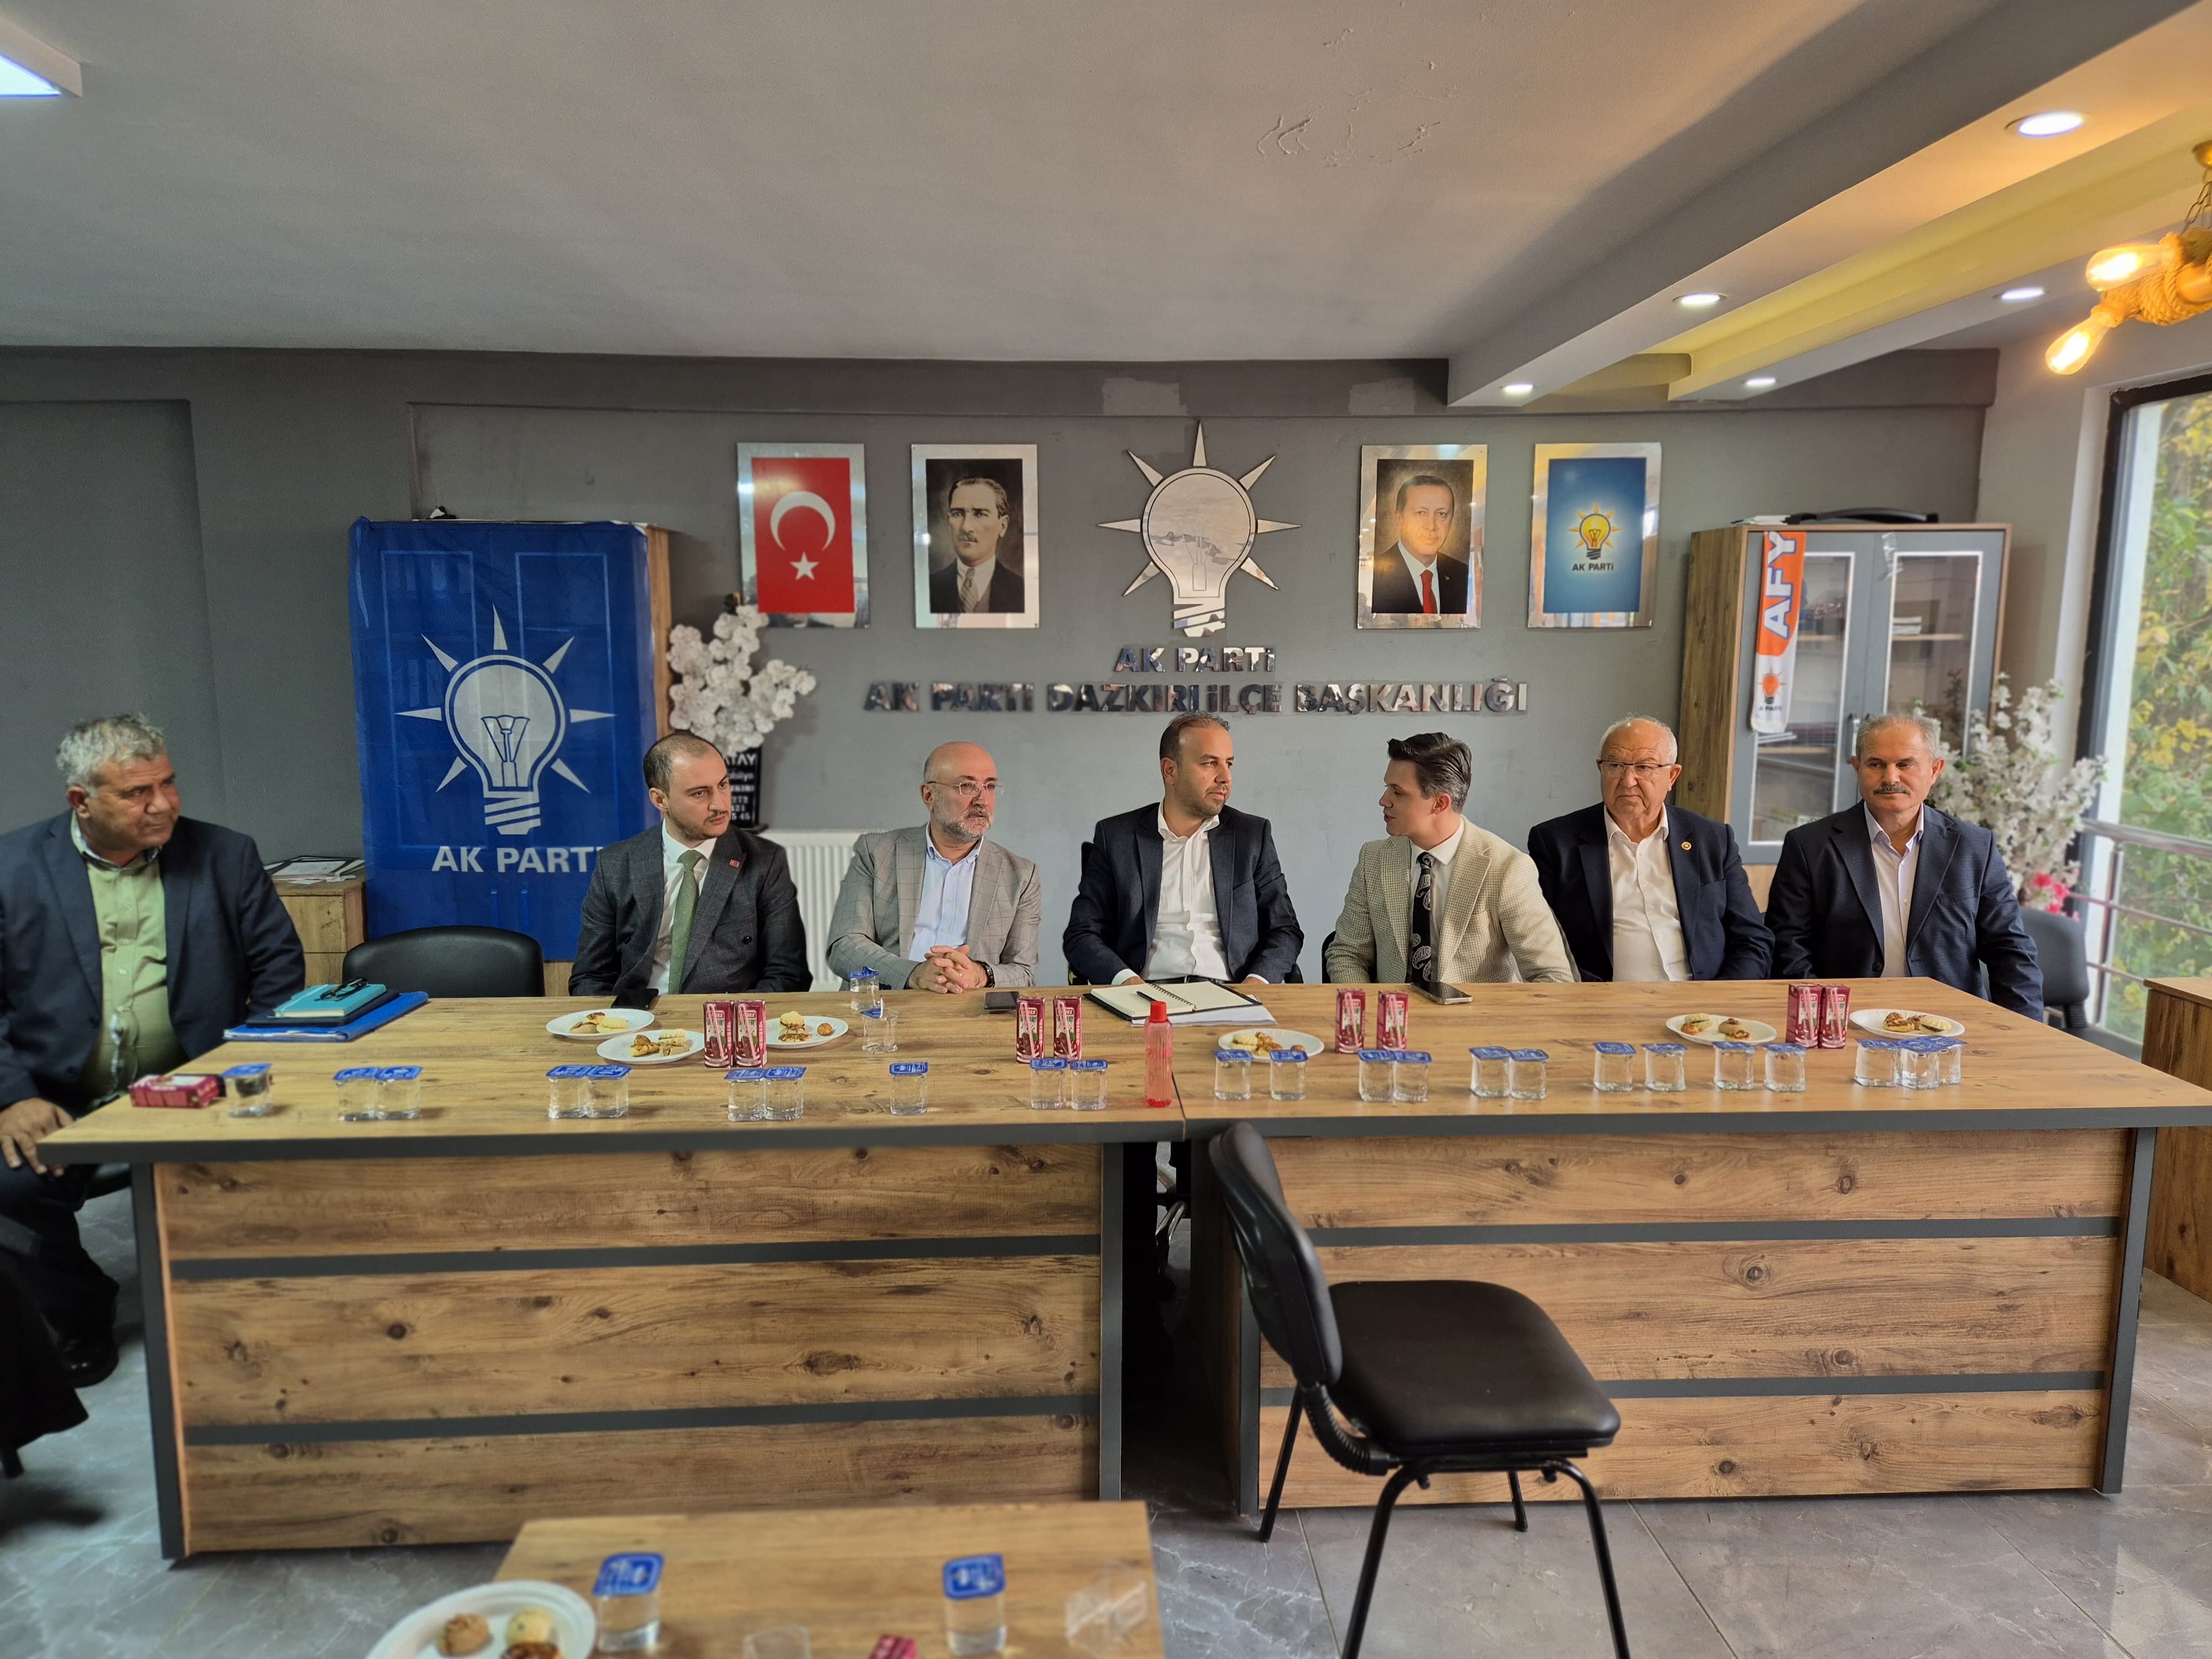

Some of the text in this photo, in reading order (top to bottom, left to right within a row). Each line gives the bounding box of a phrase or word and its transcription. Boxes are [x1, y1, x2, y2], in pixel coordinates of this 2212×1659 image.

[1572, 563, 1585, 571] AK
[1114, 647, 1165, 672] AK
[863, 682, 921, 712] AK
[1047, 684, 1199, 713] DAZKIRI
[1295, 677, 1528, 714] BAŞKANLIĞI
[431, 846, 604, 873] AK PART
